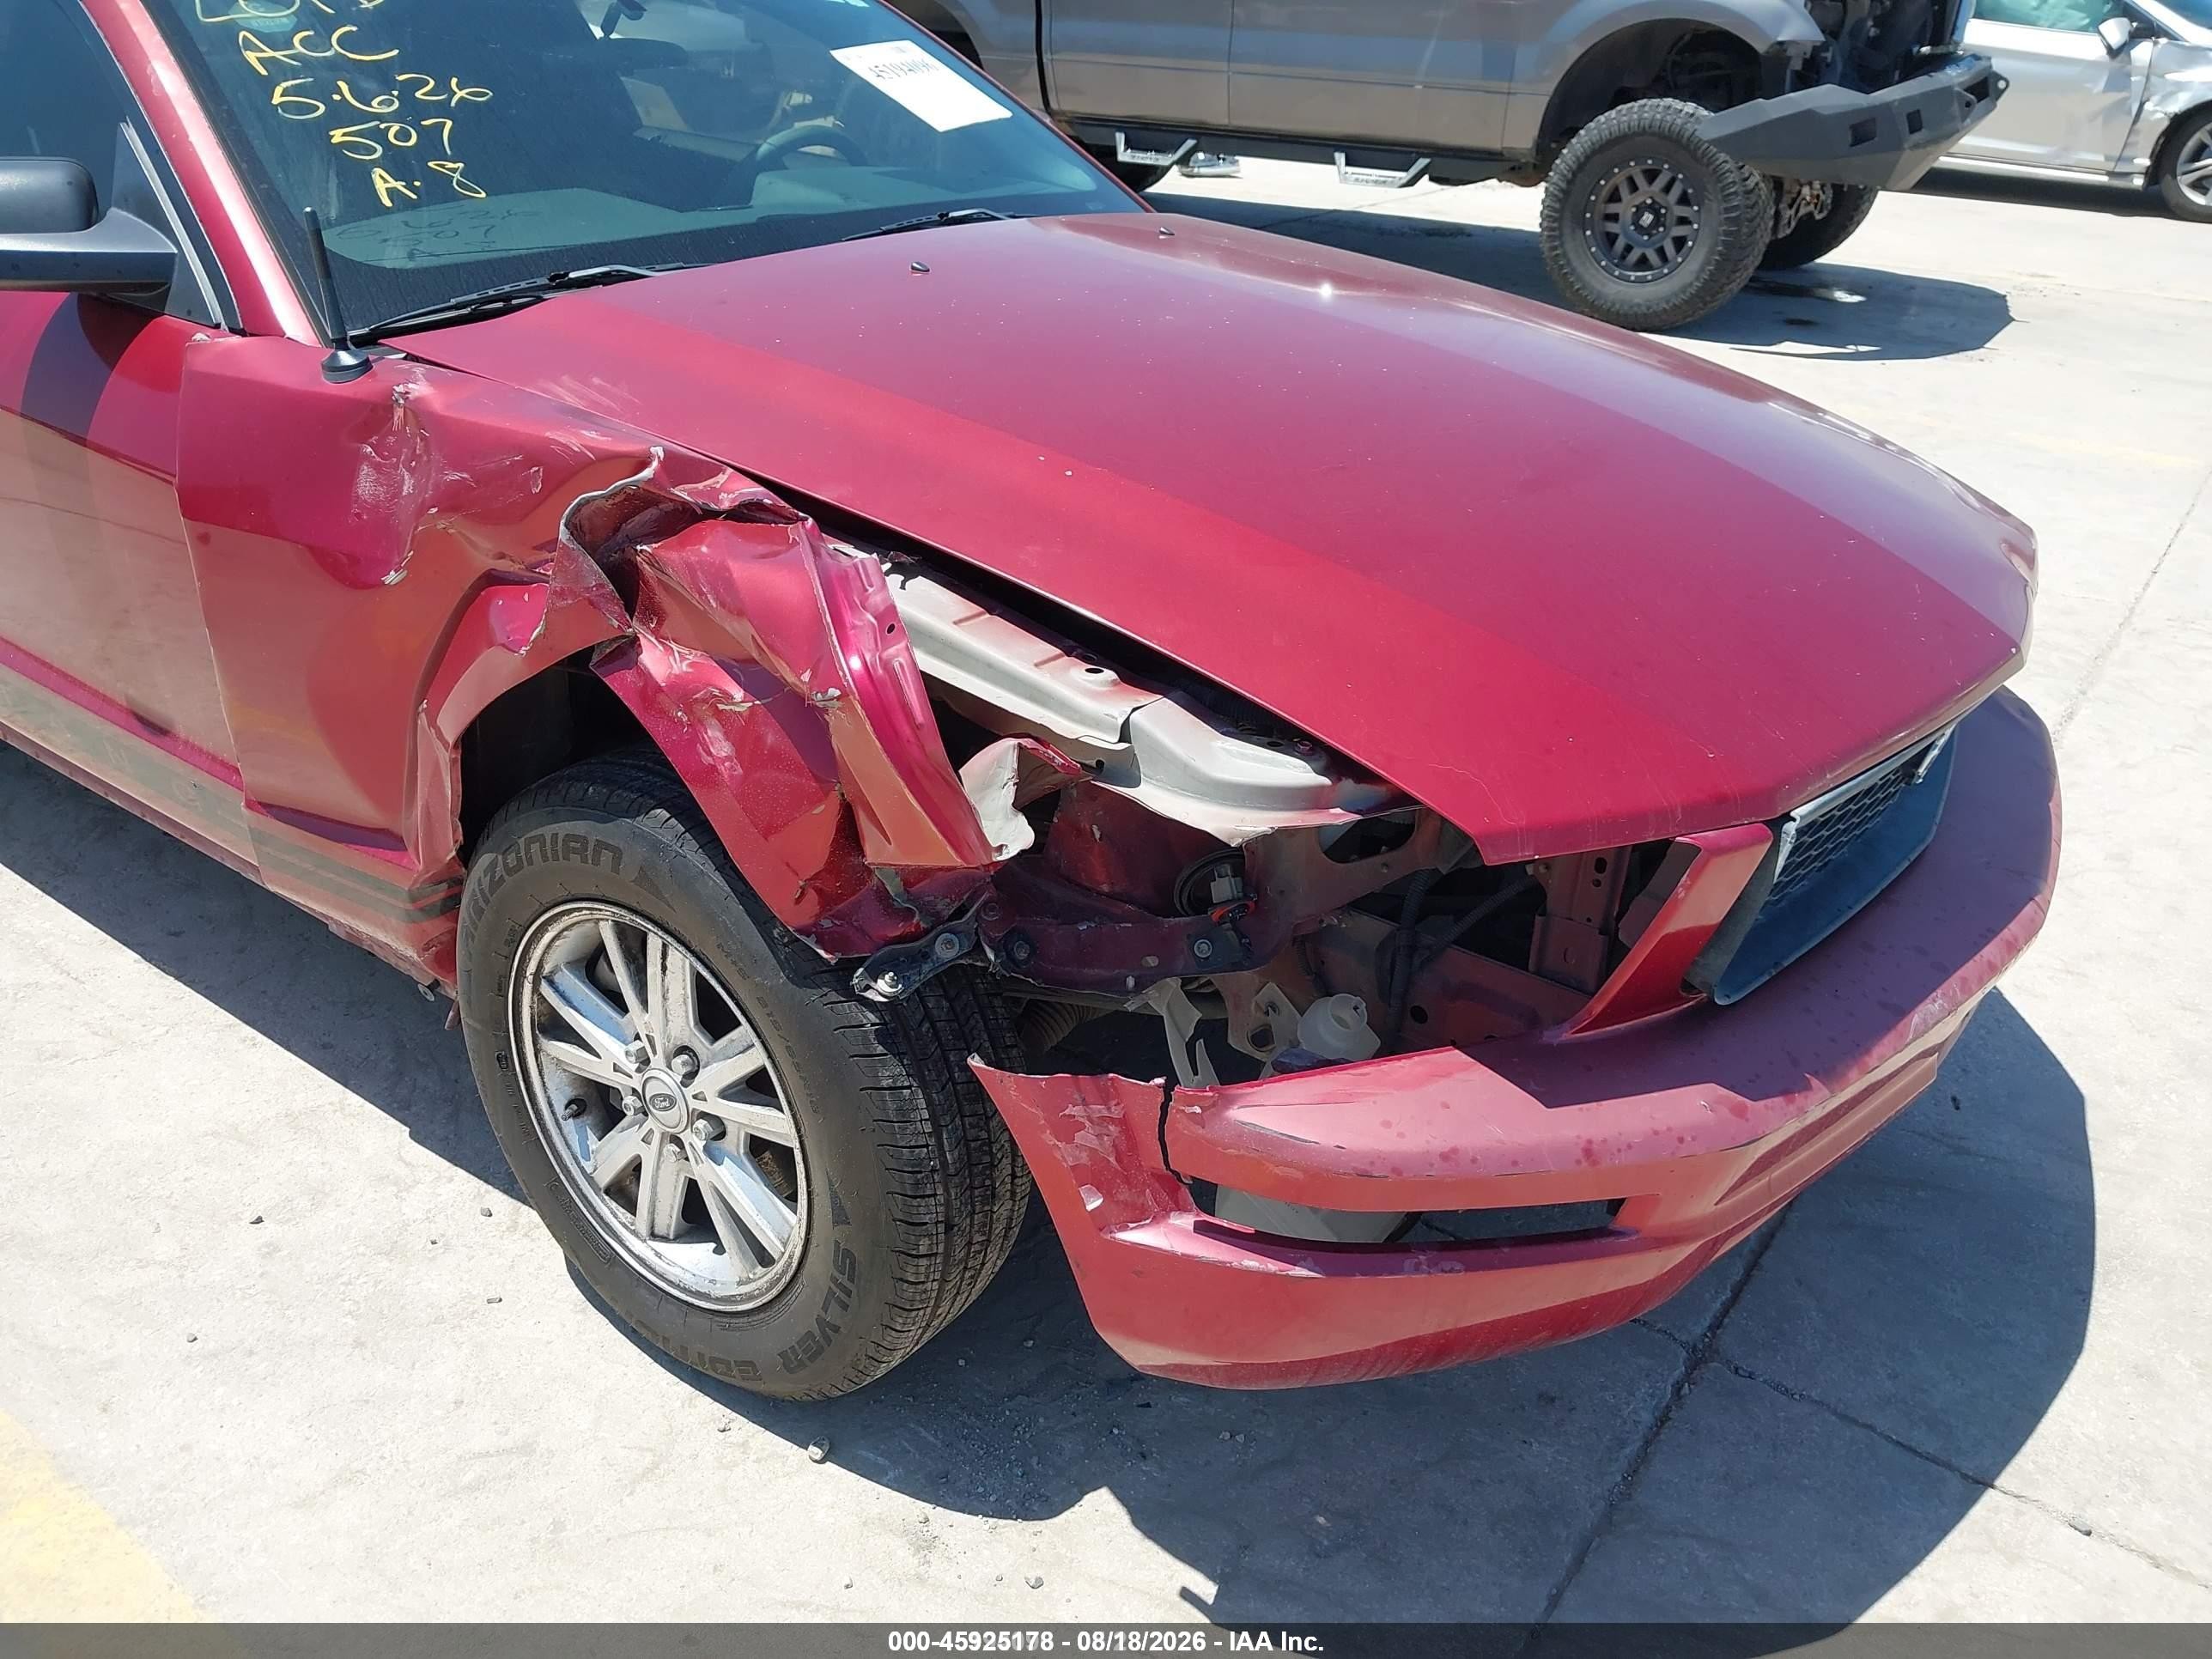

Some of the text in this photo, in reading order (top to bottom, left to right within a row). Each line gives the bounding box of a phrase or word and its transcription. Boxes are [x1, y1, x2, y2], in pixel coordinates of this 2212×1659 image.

[238, 25, 400, 76] ACC
[329, 118, 453, 160] 507
[654, 1097, 670, 1109] Ford
[776, 1240, 857, 1375] SILVER
